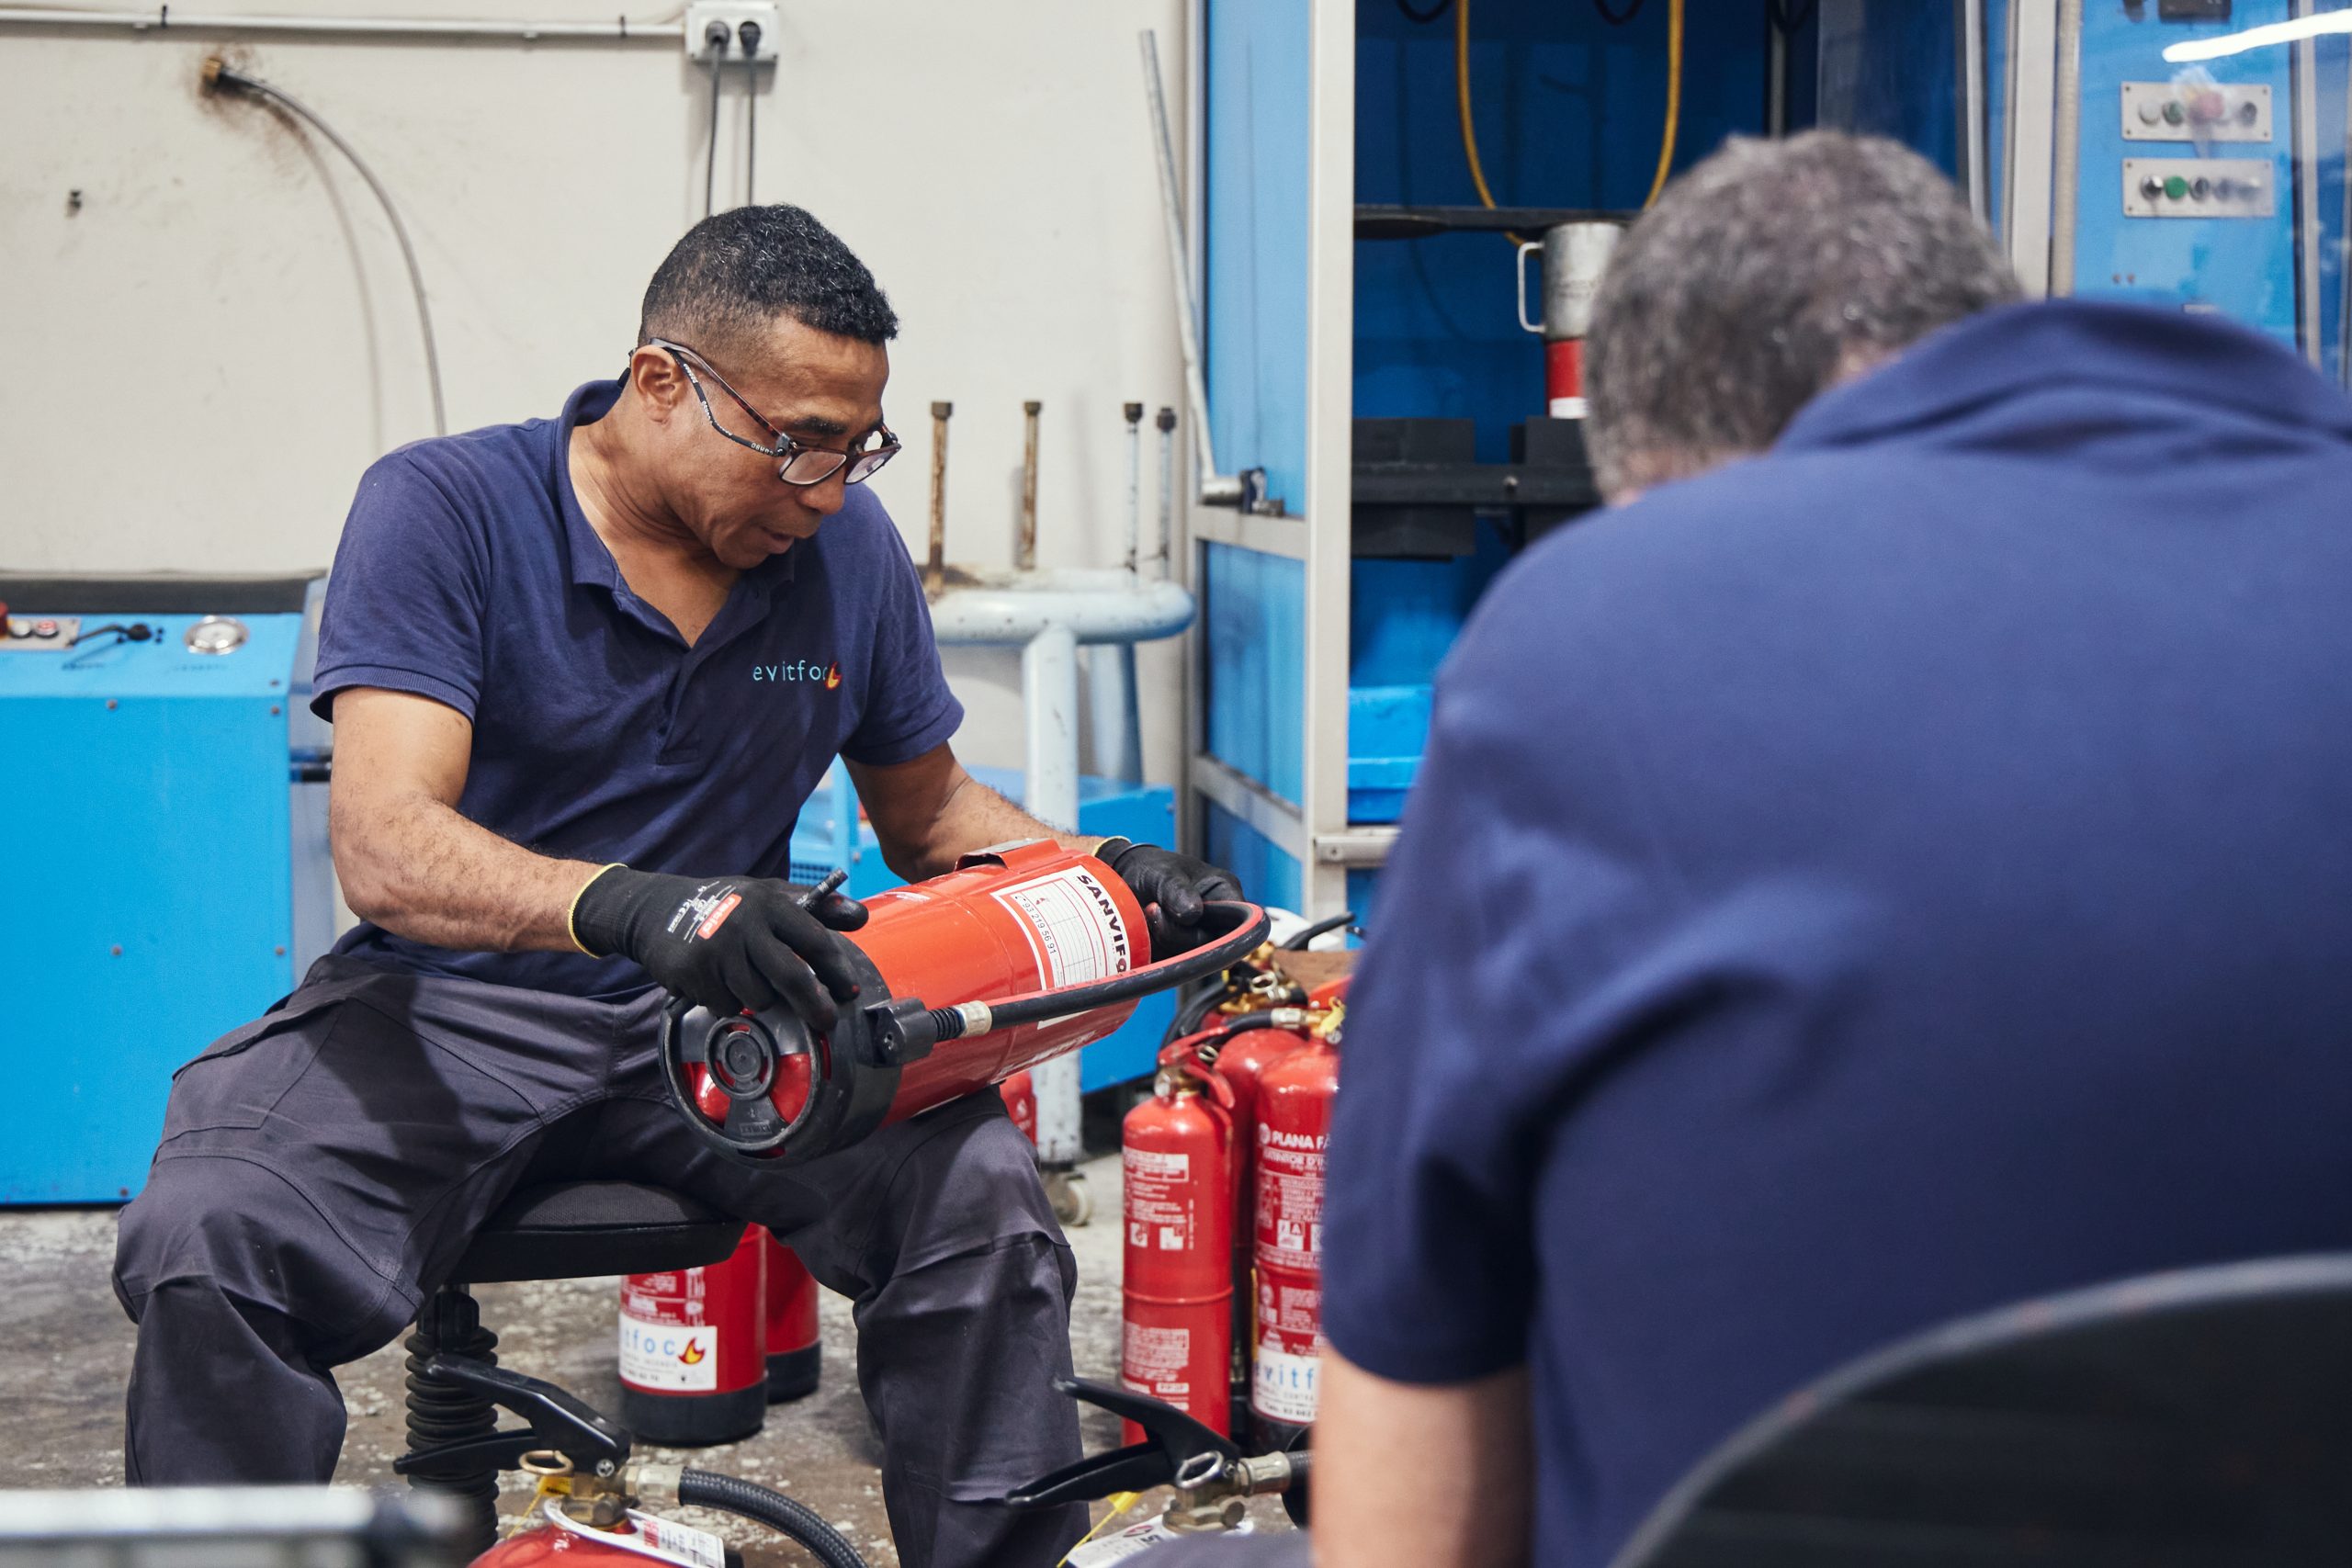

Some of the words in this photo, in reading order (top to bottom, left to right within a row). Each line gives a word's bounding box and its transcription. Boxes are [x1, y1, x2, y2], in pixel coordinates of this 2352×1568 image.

[1022, 901, 1035, 913] 93
[1031, 913, 1046, 929] 219
[1041, 930, 1052, 942] 56
[1046, 942, 1057, 955] 91
[1272, 1130, 1315, 1150] PLANA
